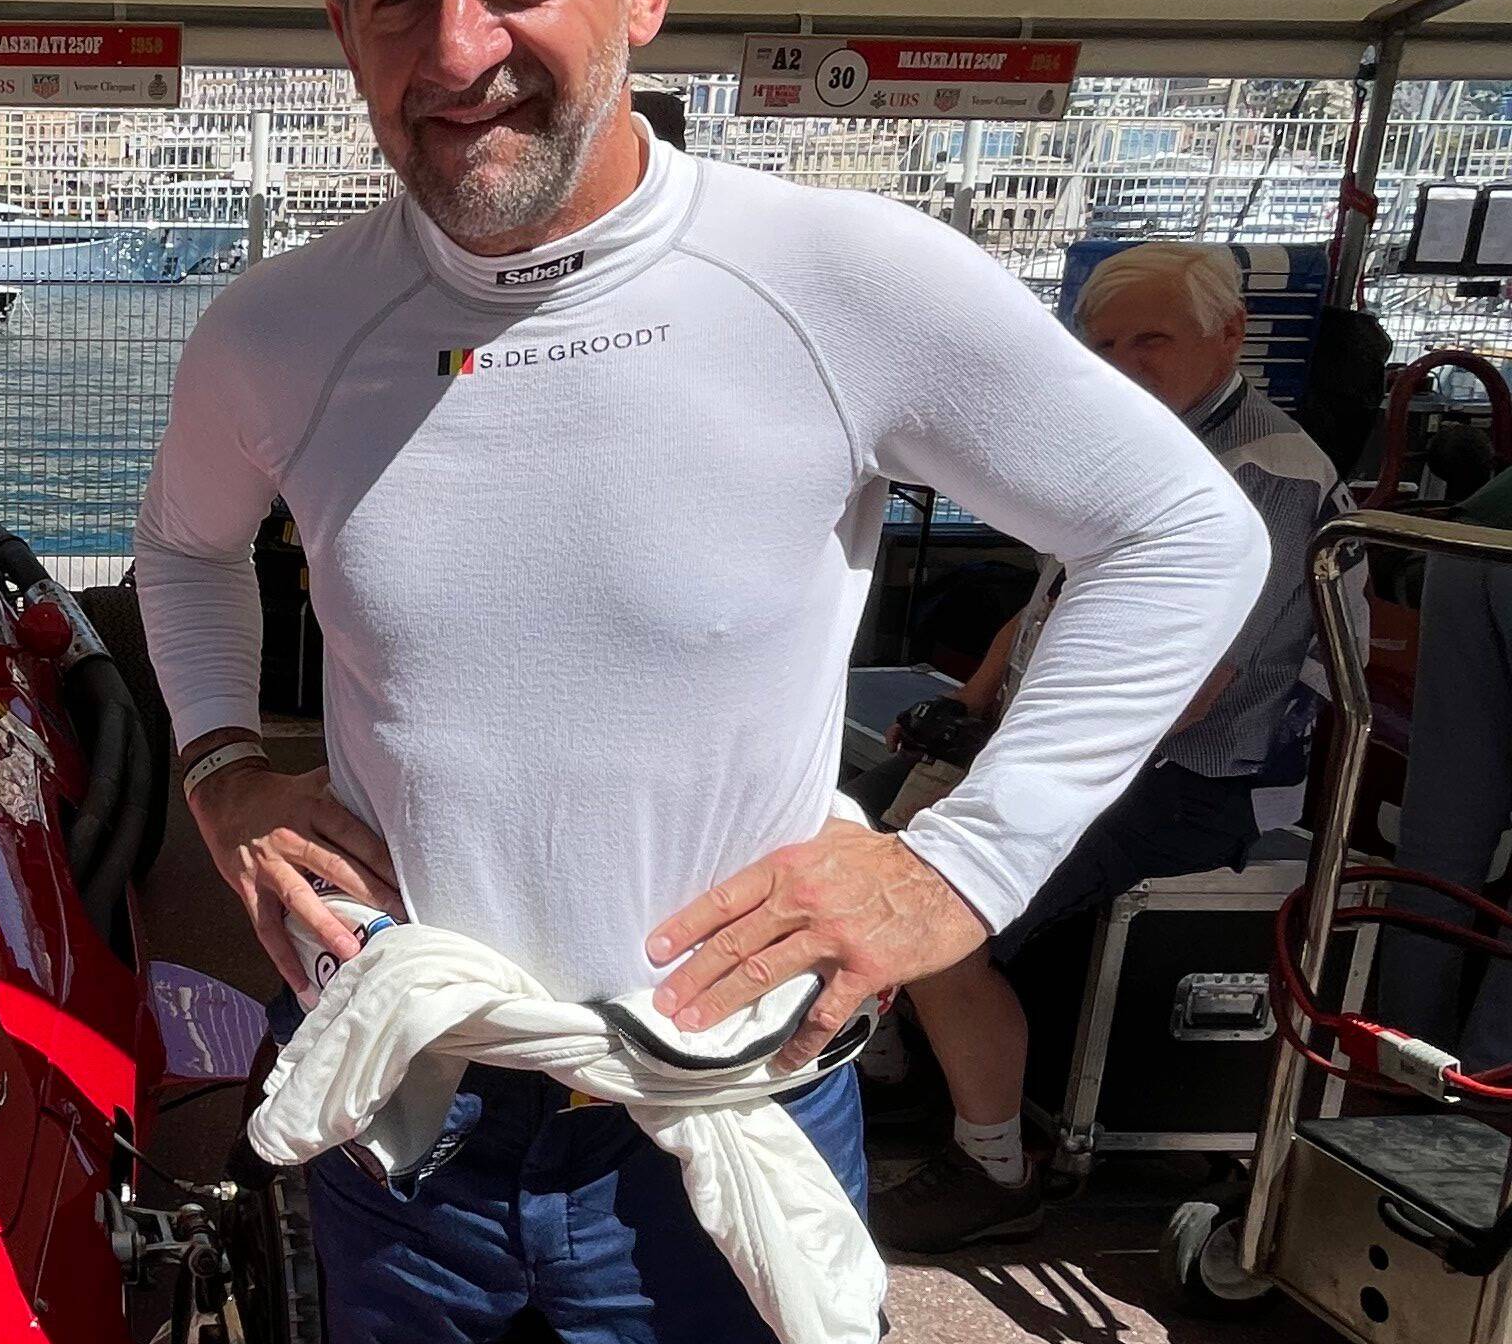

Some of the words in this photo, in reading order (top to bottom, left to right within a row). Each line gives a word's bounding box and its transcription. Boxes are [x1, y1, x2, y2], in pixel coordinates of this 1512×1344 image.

[68, 36, 104, 54] 250F
[771, 47, 802, 70] A2
[897, 51, 973, 69] MASERATI
[973, 53, 1008, 70] 250F
[828, 66, 856, 89] 30
[888, 92, 921, 107] UBS
[504, 254, 578, 286] Sabelt
[479, 347, 539, 370] S.DE
[548, 324, 671, 362] GROODT
